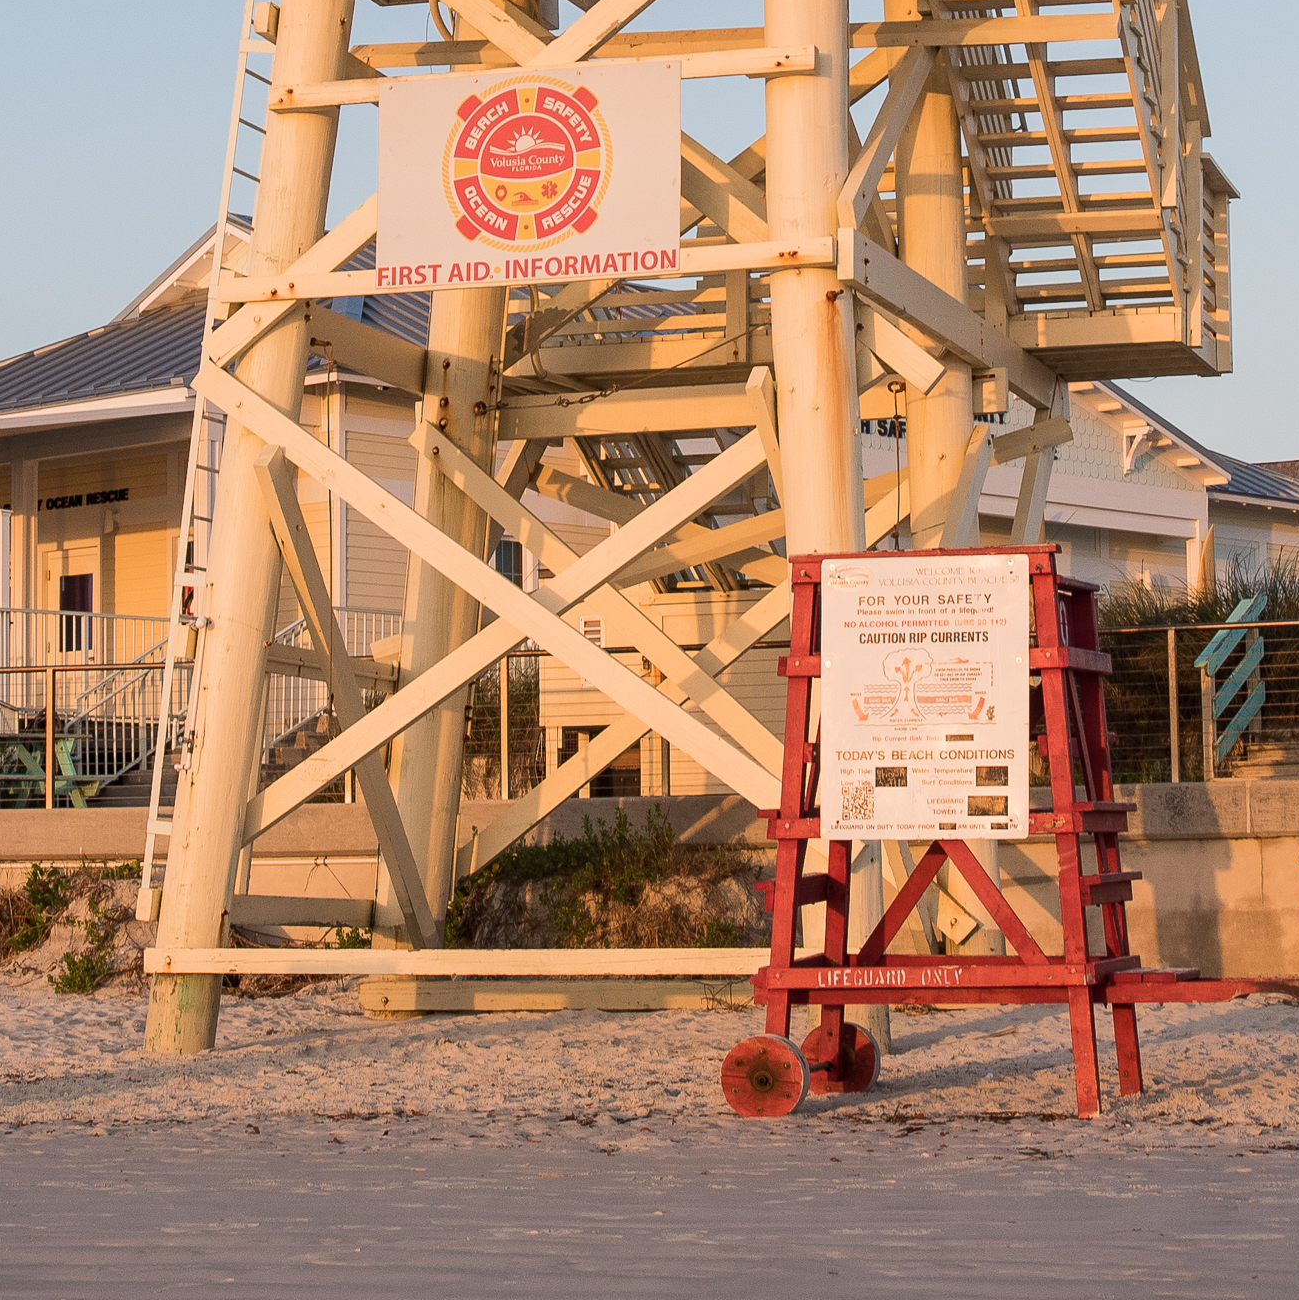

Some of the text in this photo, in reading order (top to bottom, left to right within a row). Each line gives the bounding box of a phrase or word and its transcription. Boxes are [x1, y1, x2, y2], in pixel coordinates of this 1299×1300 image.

[464, 96, 593, 151] BEACH SAFETY
[490, 154, 566, 168] Volusia County
[464, 175, 592, 231] OCEAN RESCUE
[377, 249, 678, 287] FIRST AID INFORMATION
[46, 494, 83, 511] OCEAN
[85, 488, 130, 506] RESCUE
[879, 577, 920, 587] VOLUSIA
[921, 576, 965, 586] COUNTY
[858, 593, 992, 607] FOR YOUR SAFETY
[857, 608, 882, 616] Please
[918, 607, 936, 615] front
[858, 620, 899, 628] ALCOHOL
[901, 619, 950, 628] PERMITTED
[859, 630, 989, 644] CAUTION RIP CURRENTS
[835, 748, 1015, 761] TODAY'S BEACH CONDITIONS
[933, 767, 975, 775] Temperature:
[817, 967, 963, 988] LIFEGUARD ONLY
